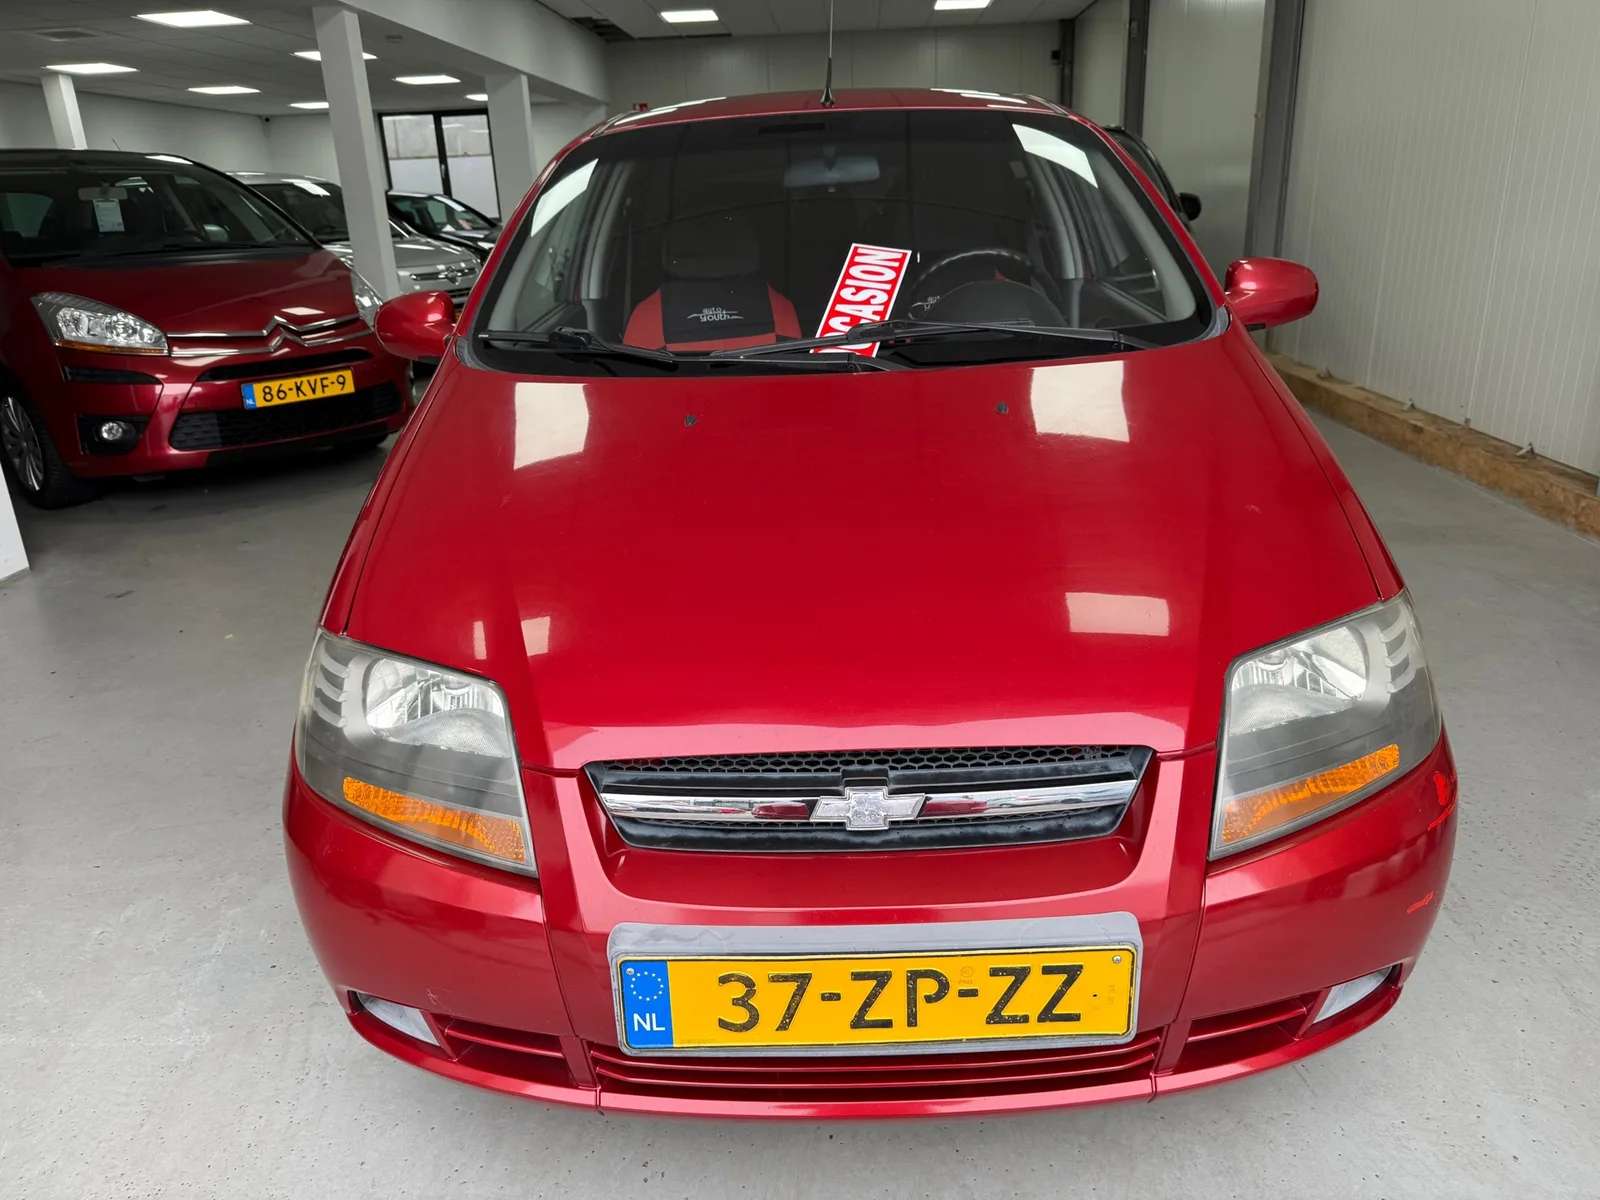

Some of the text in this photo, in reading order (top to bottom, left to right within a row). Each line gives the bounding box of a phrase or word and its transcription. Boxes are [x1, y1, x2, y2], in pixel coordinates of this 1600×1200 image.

[262, 374, 346, 403] 86-KVF-9
[717, 964, 1084, 1032] 37-ZP-ZZ
[633, 1012, 666, 1032] NL
